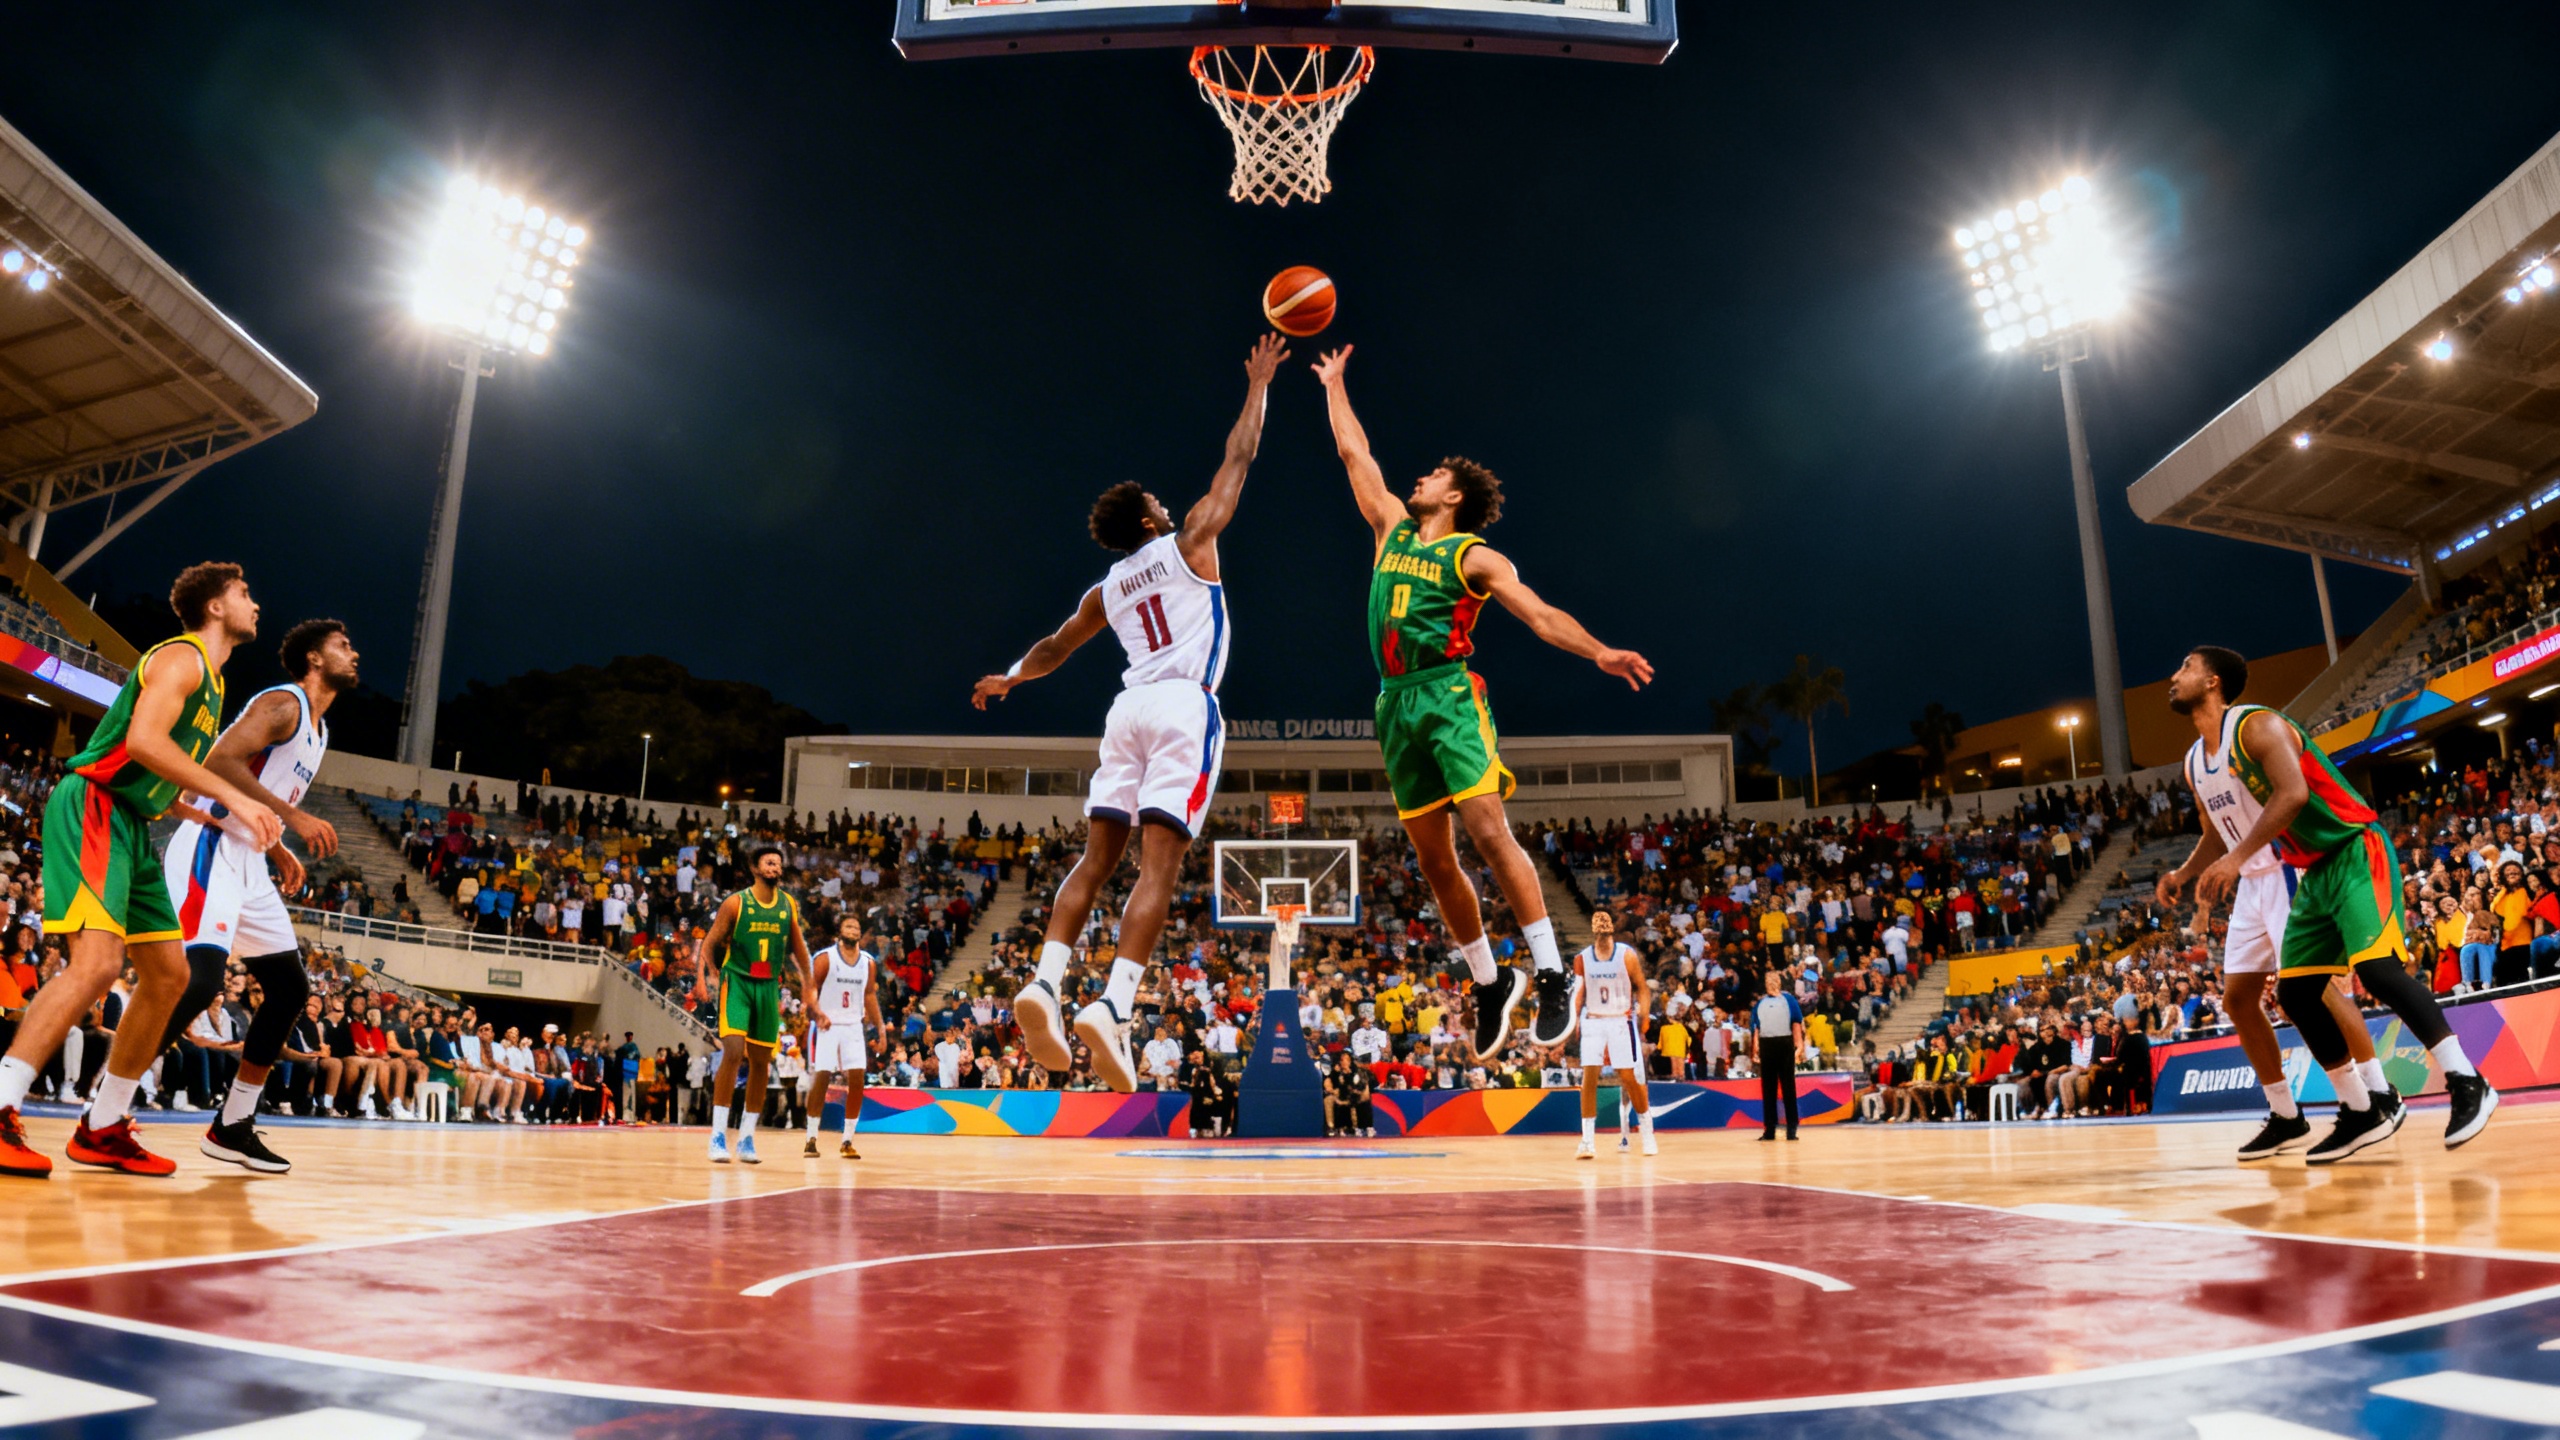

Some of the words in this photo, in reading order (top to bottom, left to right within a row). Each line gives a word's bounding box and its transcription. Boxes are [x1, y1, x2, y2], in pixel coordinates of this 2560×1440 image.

[1390, 583, 1411, 618] 0
[1135, 593, 1173, 652] 11
[758, 938, 769, 962] 1
